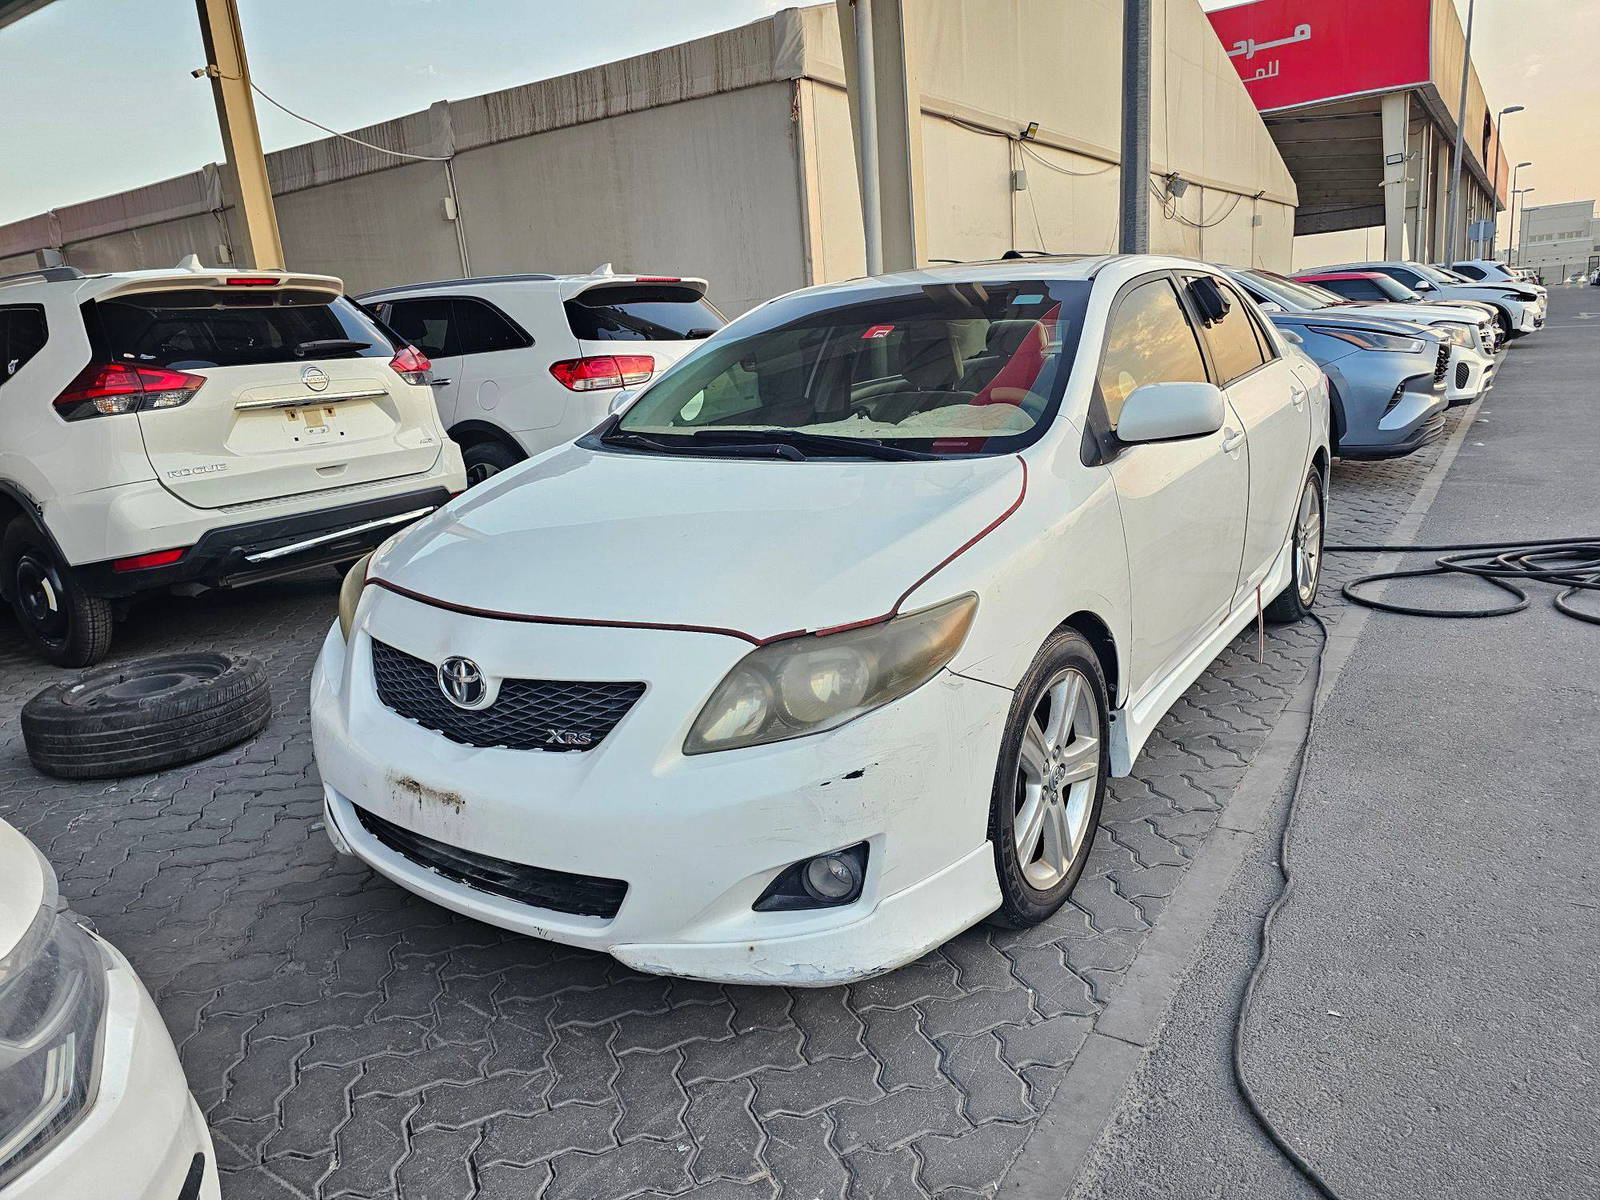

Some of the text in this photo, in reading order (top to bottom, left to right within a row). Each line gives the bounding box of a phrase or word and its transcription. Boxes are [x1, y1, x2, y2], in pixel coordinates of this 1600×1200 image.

[1226, 23, 1311, 60] مرح
[1242, 59, 1279, 83] للم
[167, 463, 227, 478] ROGUE
[546, 729, 591, 745] XRS
